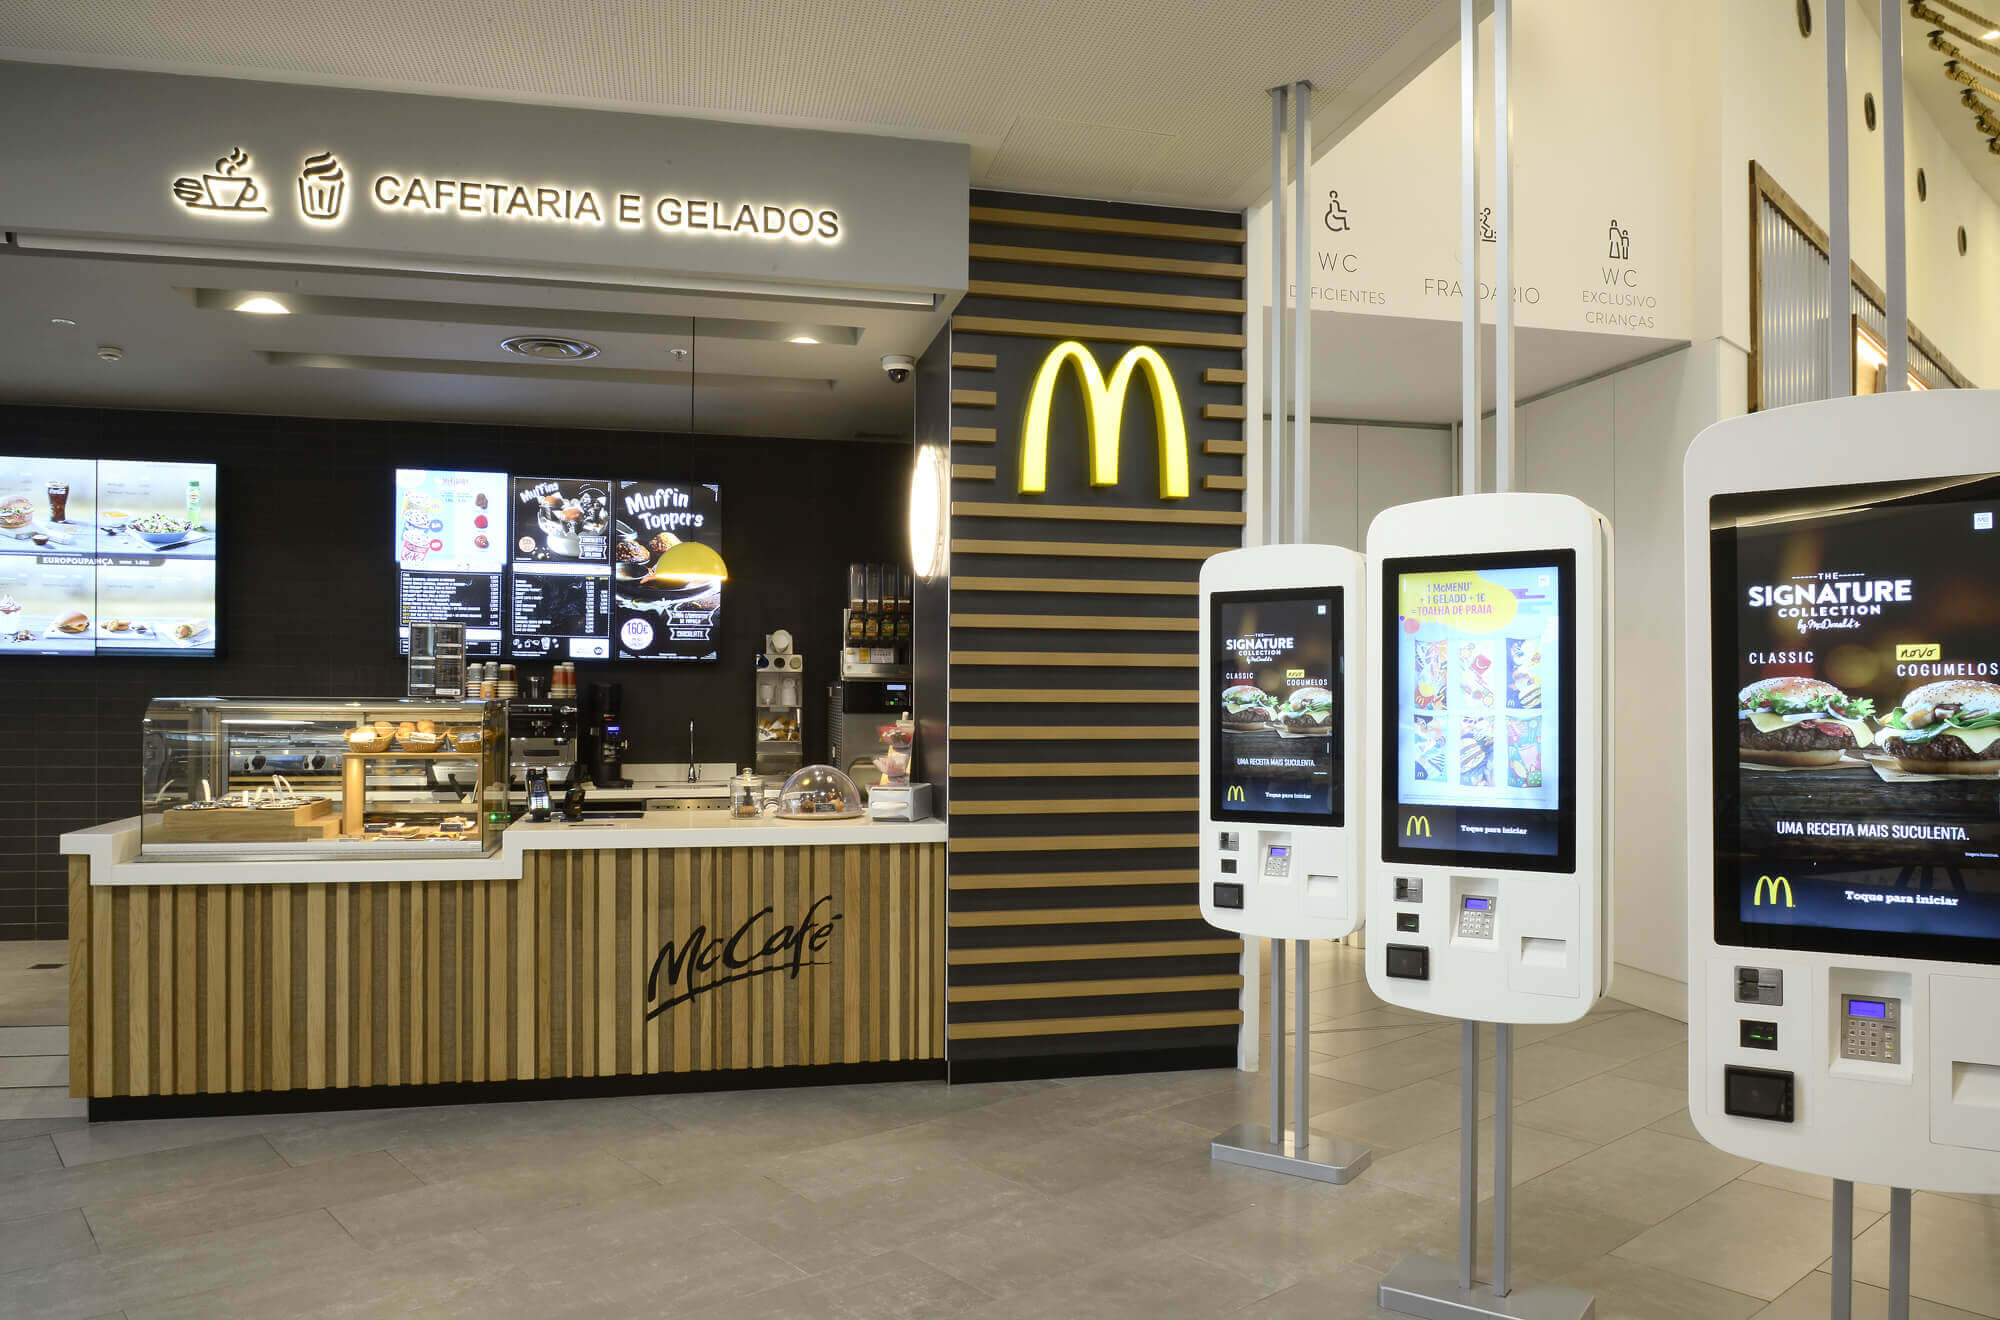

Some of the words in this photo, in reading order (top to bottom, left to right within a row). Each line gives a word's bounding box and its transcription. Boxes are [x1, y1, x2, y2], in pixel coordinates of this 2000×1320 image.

[374, 175, 601, 223] CAFETARIA
[619, 194, 642, 223] E
[657, 196, 840, 239] GELADOS
[1318, 252, 1358, 273] WC
[1602, 266, 1637, 288] WC
[1289, 284, 1386, 305] DFICIENTES
[1582, 290, 1657, 308] EXCLUSIVO
[1585, 311, 1656, 330] CRIANÇAS
[625, 488, 689, 515] Muffin
[638, 511, 704, 531] Toppers
[1817, 572, 1839, 580] THE
[1432, 594, 1467, 604] GELADO
[1748, 579, 1912, 607] SIGNATURE
[1417, 606, 1450, 616] TOALHA
[1452, 605, 1463, 615] DE
[1465, 604, 1492, 615] PRAIA
[1777, 604, 1881, 618] COLLECTION
[1797, 619, 1807, 634] by
[1225, 638, 1294, 650] SIGNATURE
[1749, 651, 1815, 664] CLASSIC
[1900, 647, 1936, 658] novo
[1225, 672, 1254, 680] CLASSIC
[1896, 662, 1999, 677] COGUMELOS
[1460, 824, 1483, 833] Toque
[1484, 826, 1502, 834] para
[1503, 826, 1528, 835] iniciar
[1776, 821, 1804, 835] UMA
[1806, 822, 1854, 837] RECEITA
[1857, 824, 1889, 838] MAIS
[1892, 825, 1970, 841] SUCULENTA.
[1845, 890, 1883, 903] Toque
[1886, 894, 1914, 905] para
[1915, 894, 1959, 906] iniciar
[648, 895, 843, 1004] McCafé
